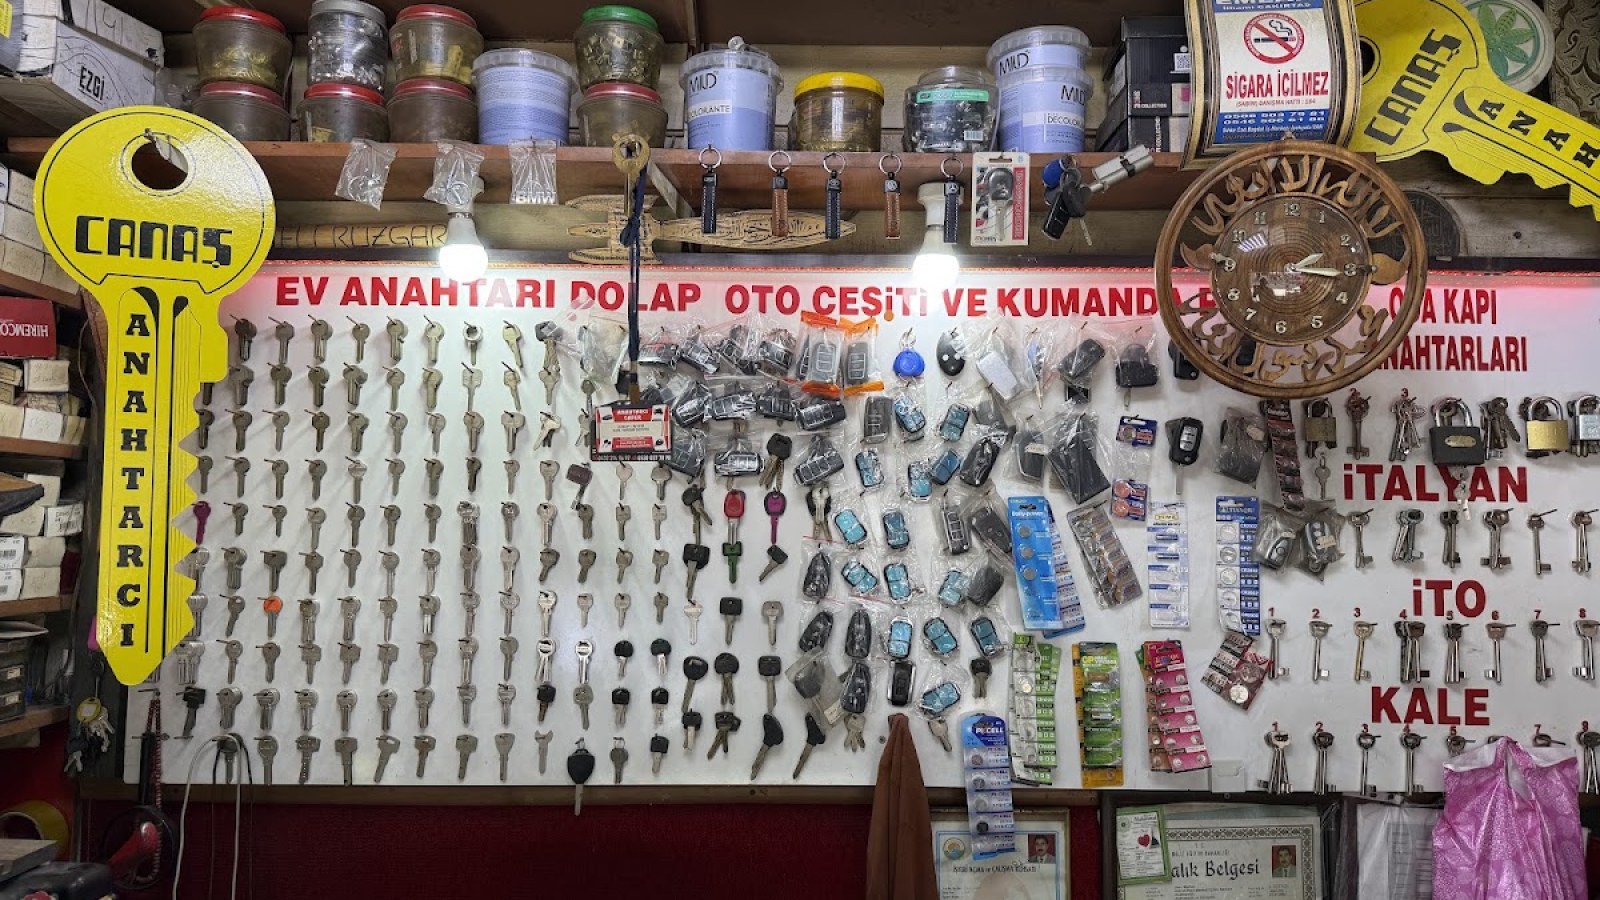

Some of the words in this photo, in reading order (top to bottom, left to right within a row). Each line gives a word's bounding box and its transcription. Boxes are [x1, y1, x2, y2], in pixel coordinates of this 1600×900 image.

[1226, 71, 1273, 99] SİGARA
[1254, 211, 1267, 224] 11
[1283, 203, 1300, 217] 12
[1319, 211, 1326, 223] 1
[276, 277, 330, 306] EV
[339, 277, 556, 308] ANAHTARI
[725, 284, 801, 315] OTO
[942, 287, 988, 317] VE
[1335, 291, 1348, 304] 4
[1443, 288, 1497, 325] KAPI
[1244, 308, 1257, 321] 7
[1311, 316, 1324, 329] 5
[1275, 320, 1287, 333] 6
[1376, 335, 1528, 372] NAHTARLARI
[1401, 387, 1409, 398] 3
[115, 313, 151, 648] ANAHTARCI
[1268, 607, 1275, 618] 1
[1312, 608, 1321, 619] 2
[1353, 608, 1361, 618] 3
[1399, 608, 1408, 620] 4
[1446, 610, 1454, 621] 5
[1491, 610, 1499, 620] 6
[1534, 609, 1542, 620] 7
[1578, 607, 1587, 618] 8
[1371, 686, 1490, 725] KALE
[1271, 721, 1279, 732] 1
[1315, 721, 1324, 732] 2
[1361, 723, 1369, 733] 3
[1534, 724, 1542, 735] 7
[1171, 861, 1199, 878] alık
[1205, 858, 1260, 880] Belgesi
